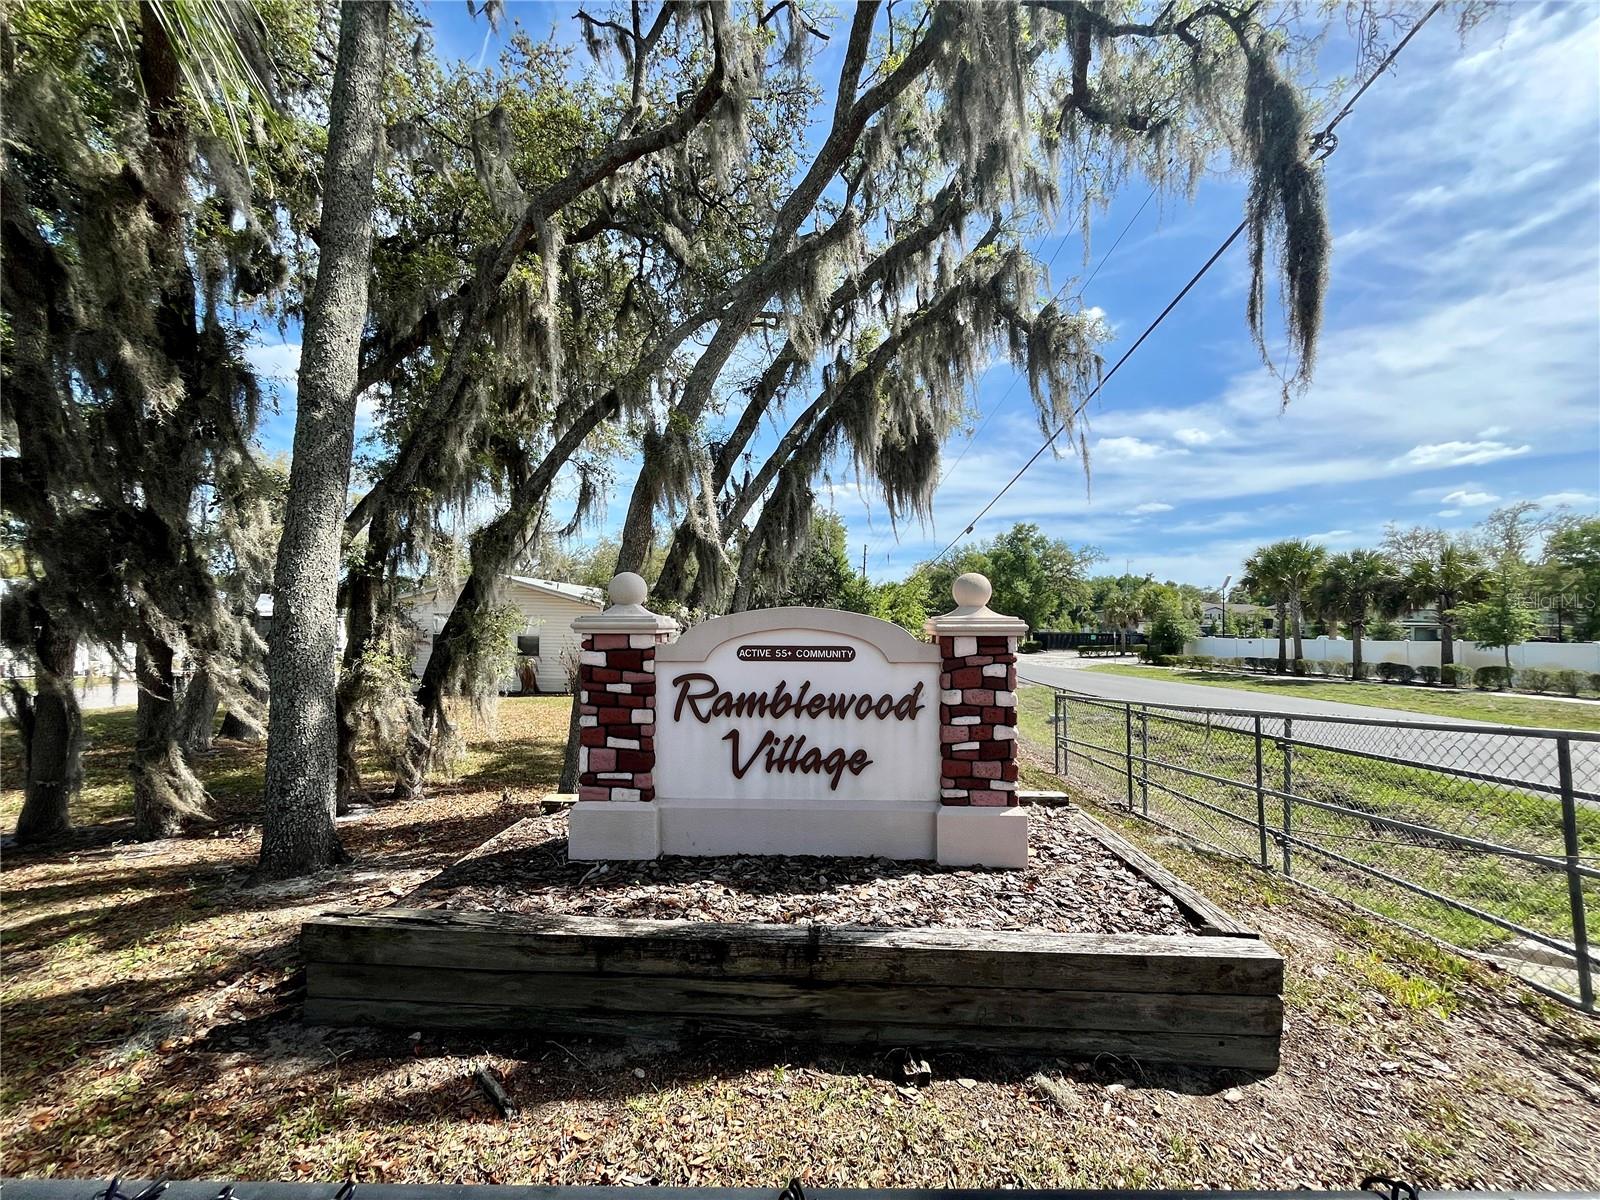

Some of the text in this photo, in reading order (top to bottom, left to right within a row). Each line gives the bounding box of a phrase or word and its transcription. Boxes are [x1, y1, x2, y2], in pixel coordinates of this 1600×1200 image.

[739, 649, 853, 659] ACTIVE 55+ COMMUNITY
[672, 672, 926, 724] Ramblewood
[722, 728, 874, 791] Village
